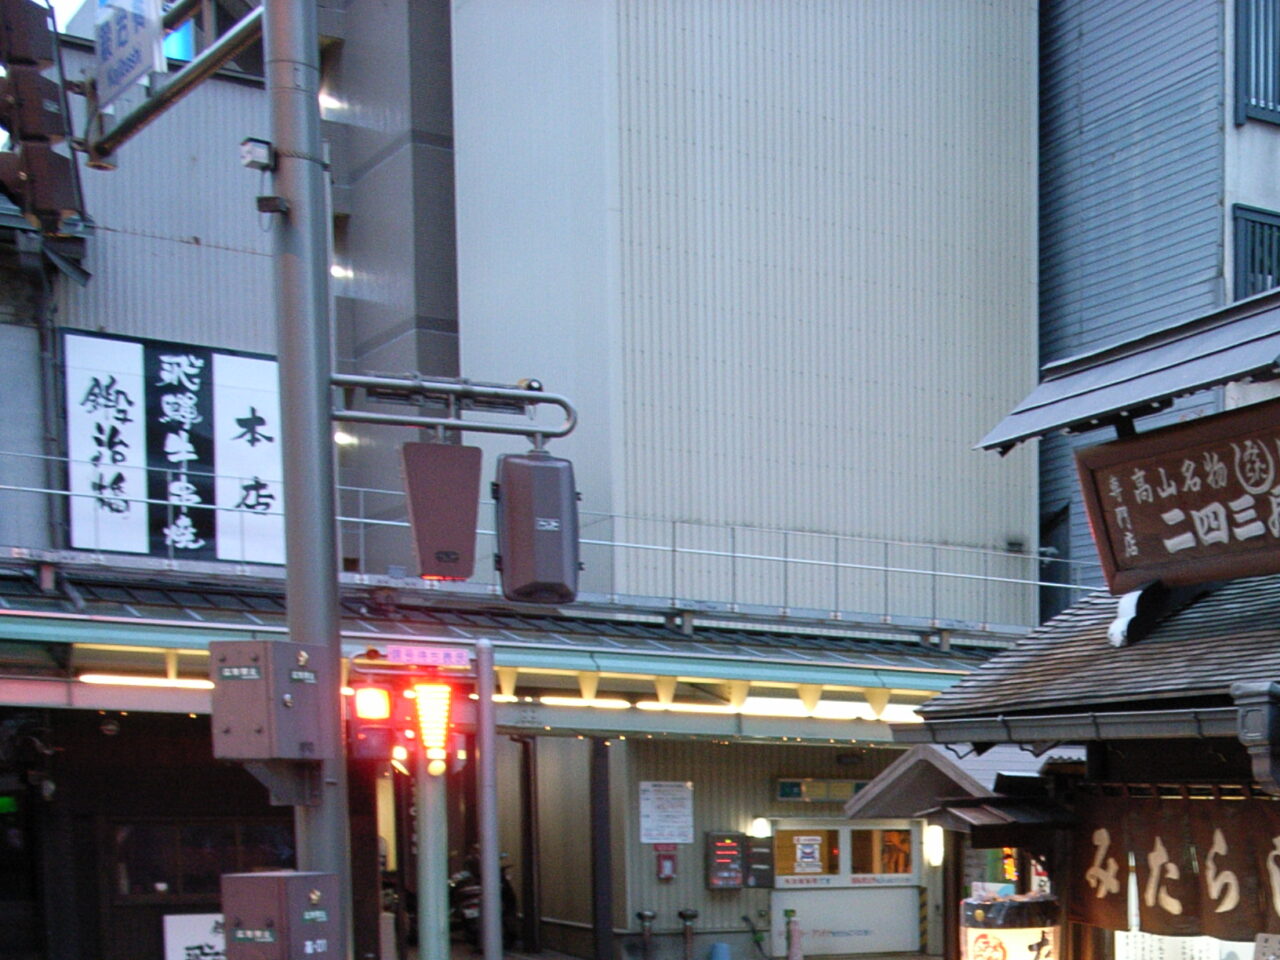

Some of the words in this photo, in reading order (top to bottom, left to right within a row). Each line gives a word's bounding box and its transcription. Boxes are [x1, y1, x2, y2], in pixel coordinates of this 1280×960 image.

[231, 405, 276, 515] 本店
[1131, 451, 1228, 505] 高山名物
